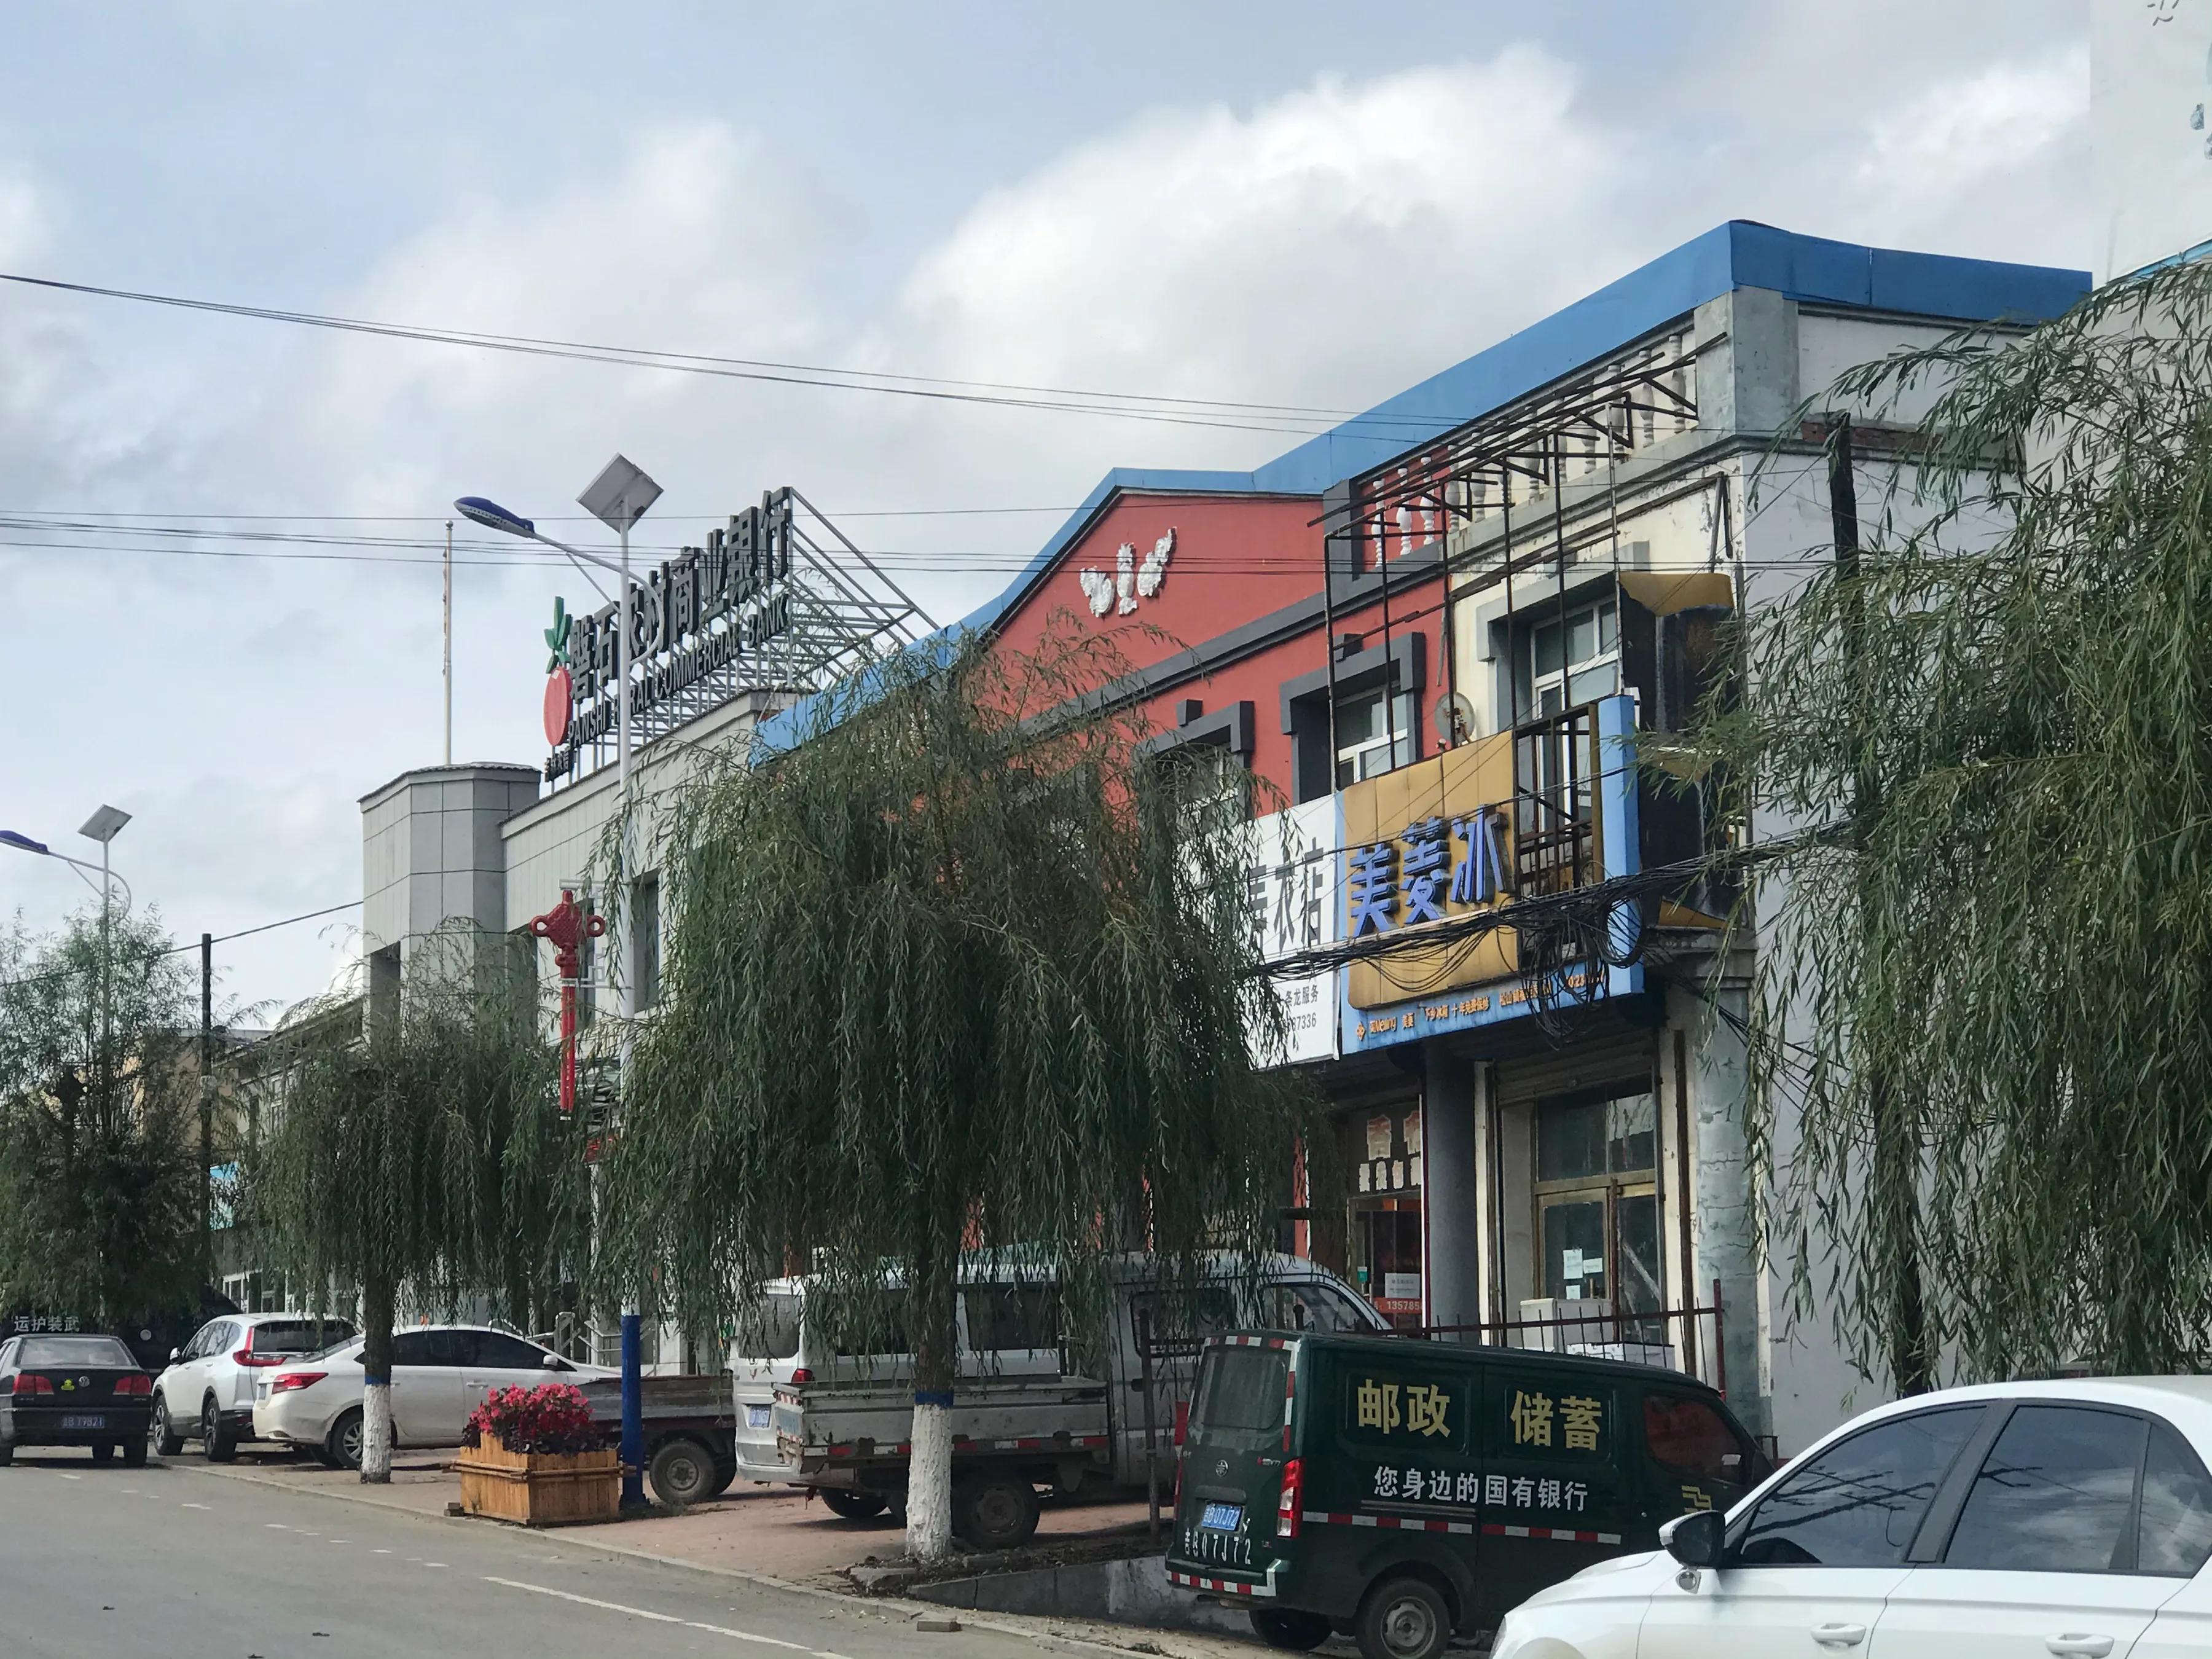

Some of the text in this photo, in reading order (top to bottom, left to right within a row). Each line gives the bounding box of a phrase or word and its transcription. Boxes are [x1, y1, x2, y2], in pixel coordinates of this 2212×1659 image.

[568, 594, 788, 748] PANSHI RRAL COMMERCIAL BANK
[1357, 1378, 1602, 1451] 邮政 储蓄
[1374, 1465, 1589, 1512] 您身边的国有银行
